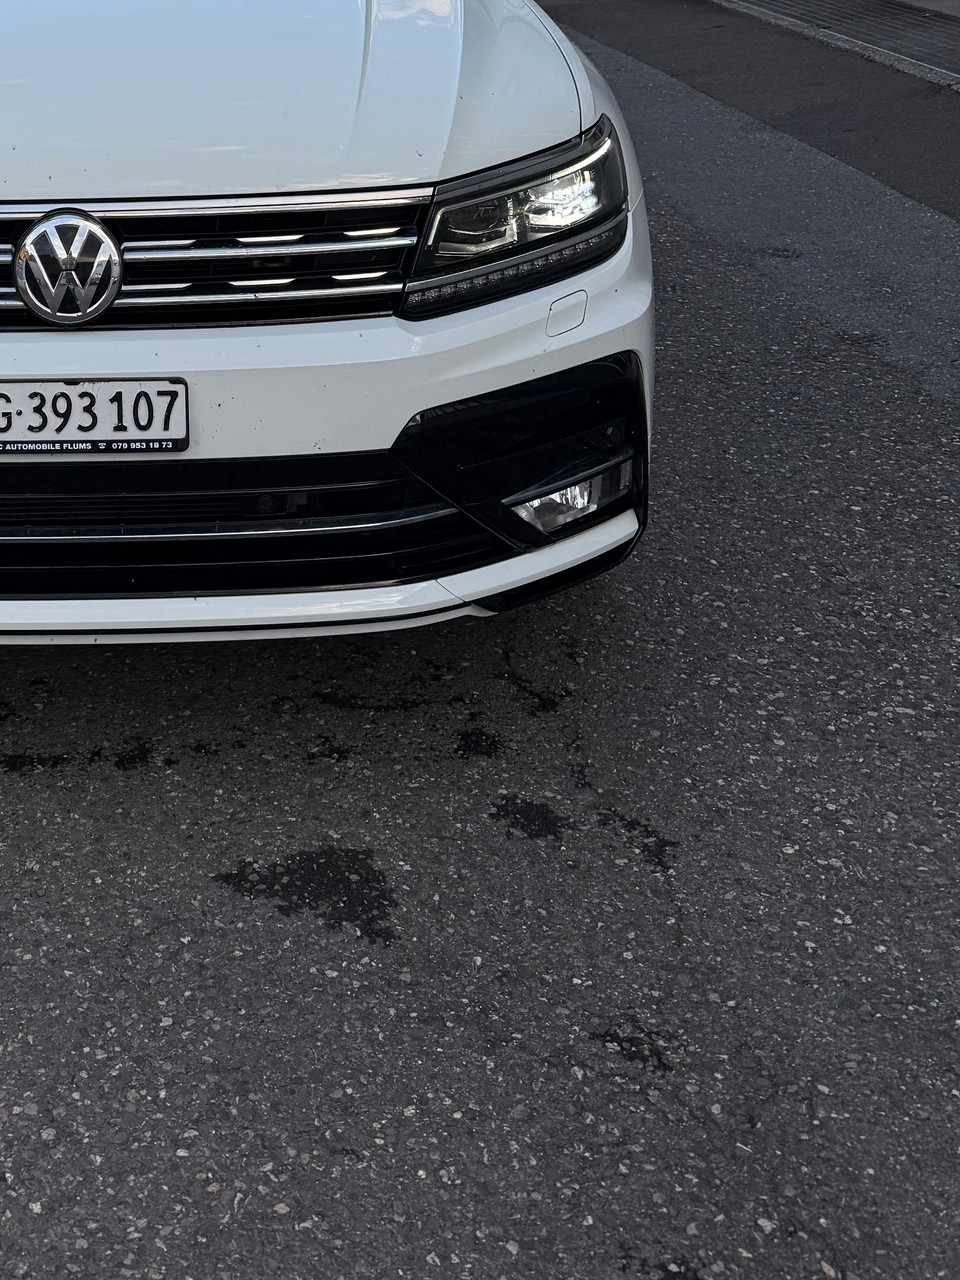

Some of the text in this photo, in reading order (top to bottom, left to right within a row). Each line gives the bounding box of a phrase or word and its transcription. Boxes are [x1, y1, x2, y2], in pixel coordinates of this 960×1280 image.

[5, 443, 61, 451] AUTOMOBILE
[63, 442, 92, 450] FLUMS
[112, 442, 128, 450] 079
[130, 442, 147, 450] 953
[149, 441, 160, 449] 18
[161, 441, 173, 449] 73
